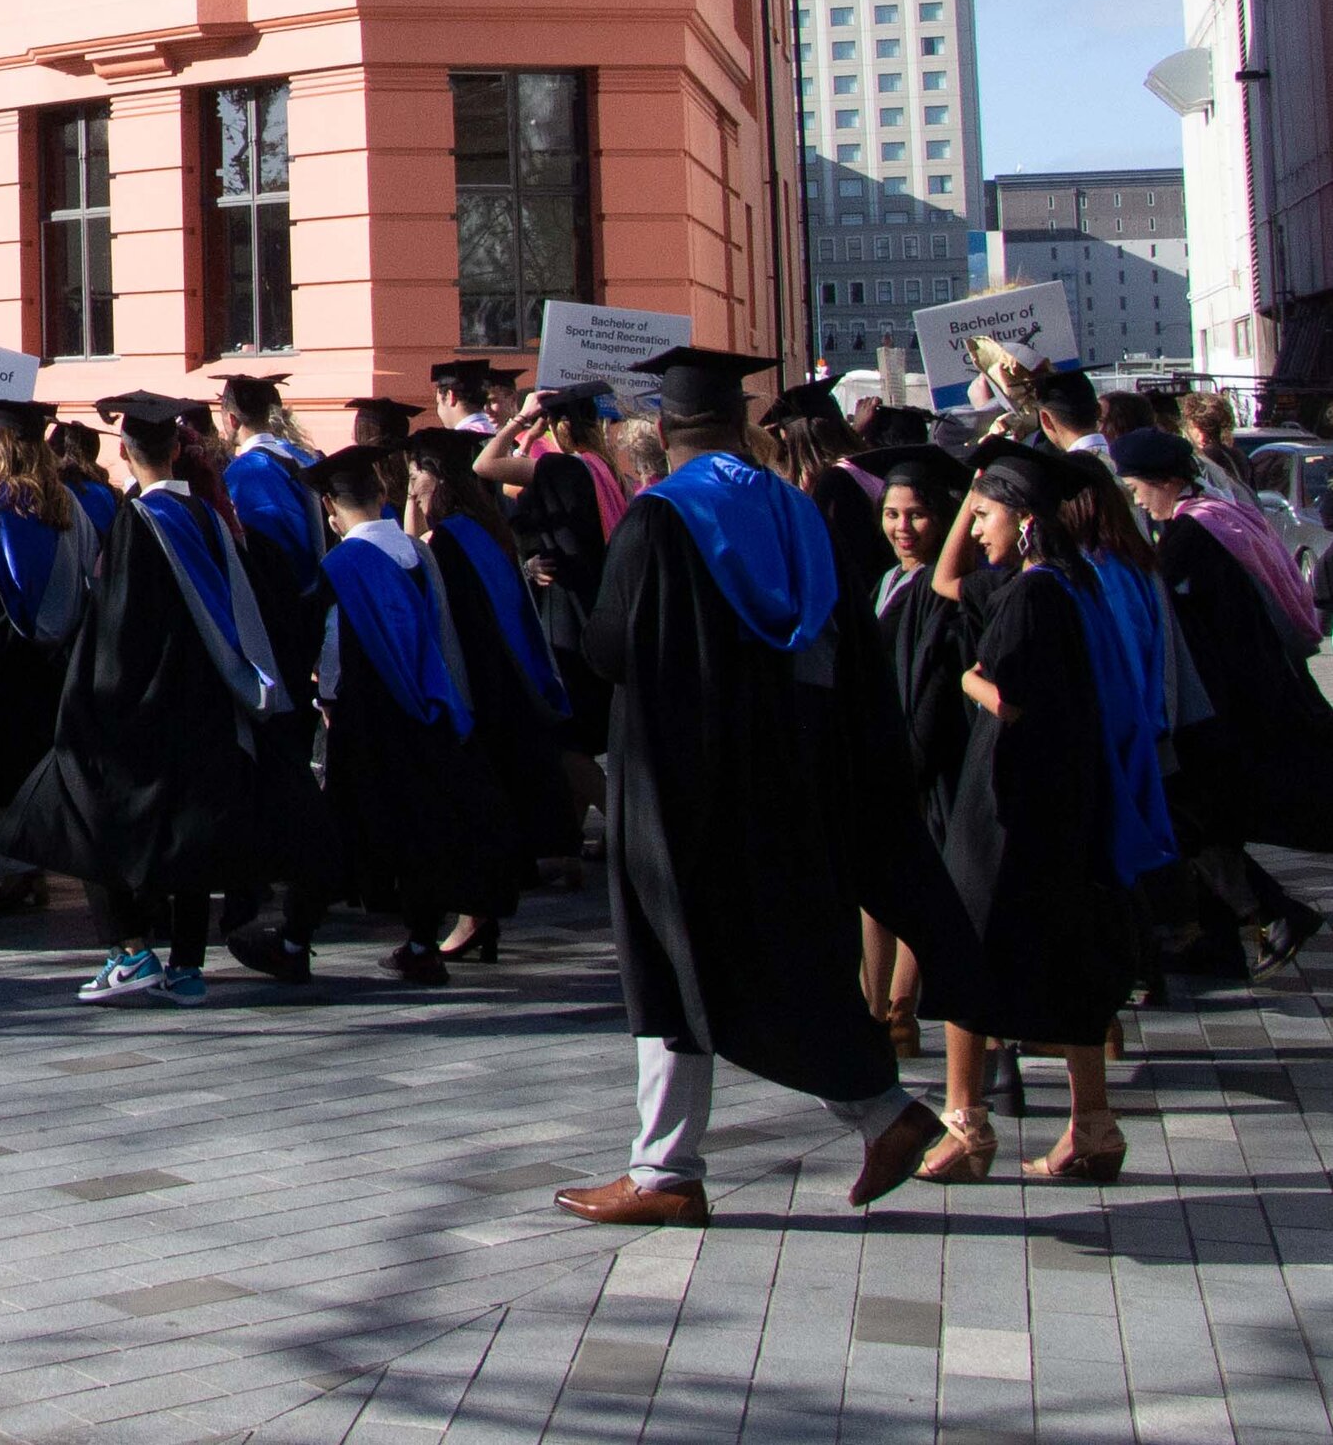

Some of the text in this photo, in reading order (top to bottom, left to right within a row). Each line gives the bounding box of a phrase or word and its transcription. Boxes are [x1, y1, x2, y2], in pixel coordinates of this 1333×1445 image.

[591, 316, 648, 331] Bachelor of
[948, 304, 1035, 335] Bachelor of
[565, 325, 670, 346] Sport and Recreation
[580, 340, 646, 356] Management
[586, 359, 630, 373] Bachelo
[0, 370, 14, 383] of
